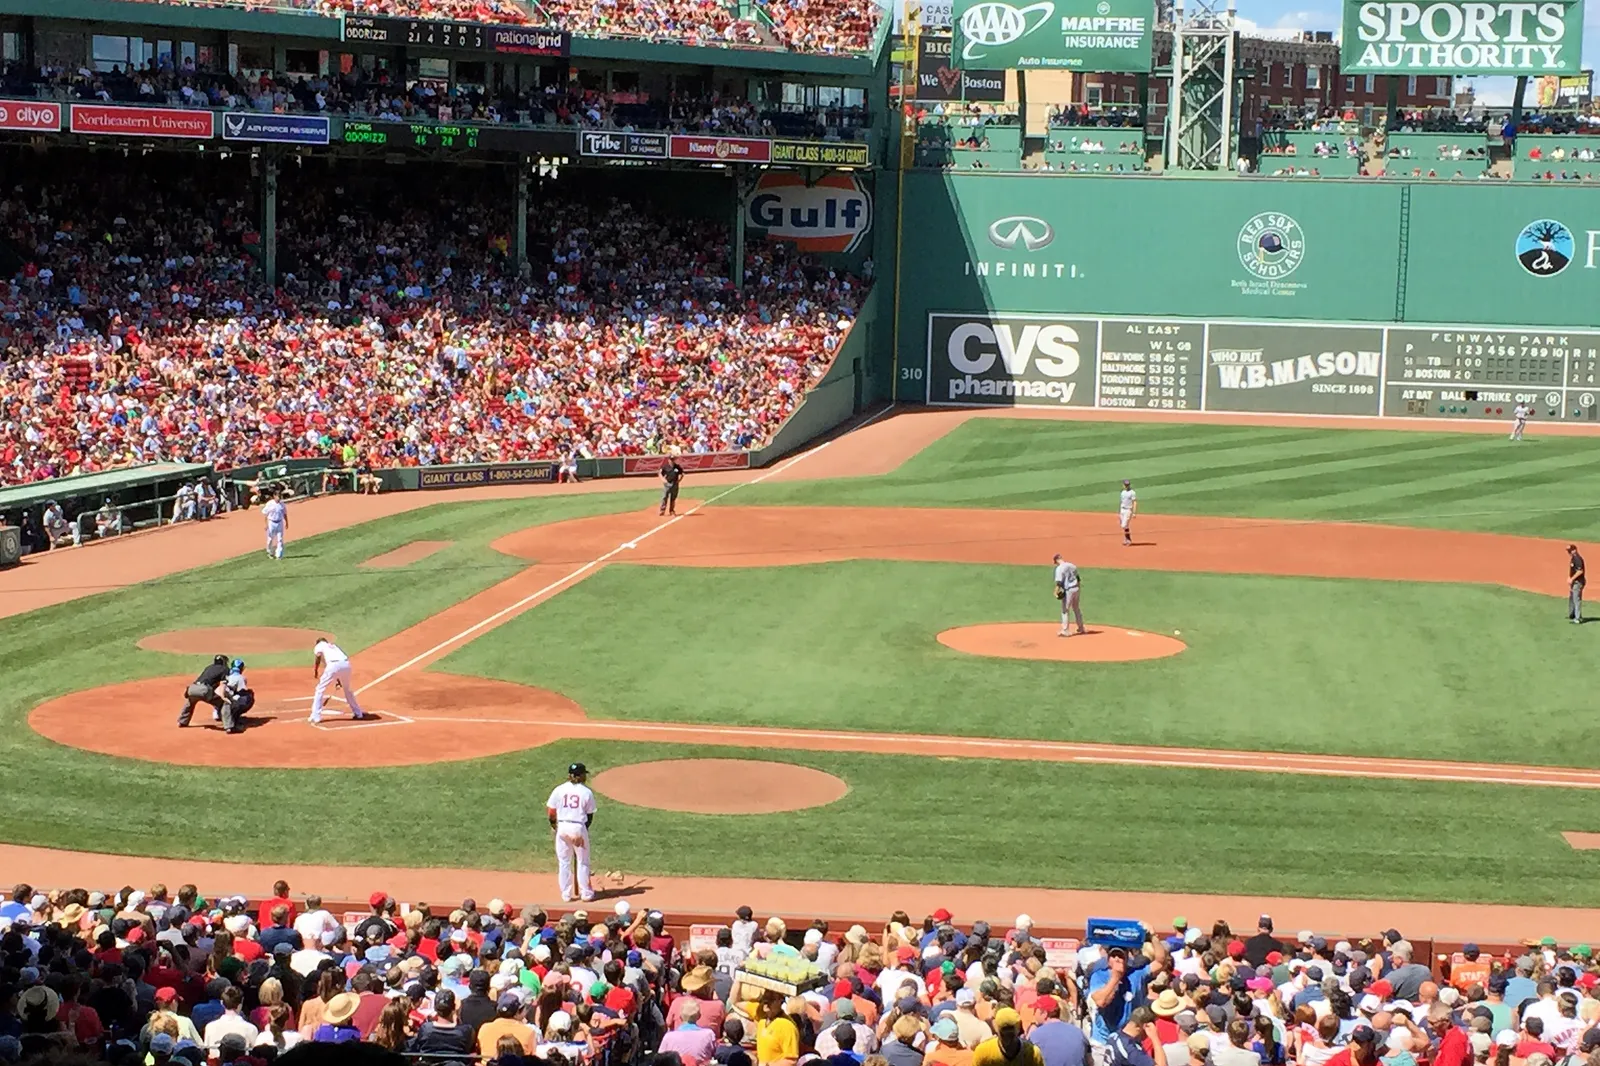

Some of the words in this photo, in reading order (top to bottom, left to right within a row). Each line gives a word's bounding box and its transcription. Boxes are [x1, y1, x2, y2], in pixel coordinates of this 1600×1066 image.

[926, 5, 953, 15] CAS
[966, 5, 1018, 42] AAA
[1061, 17, 1145, 31] MAPFRE
[1358, 2, 1565, 42] SPORTS
[346, 28, 387, 40] ODORIZZI
[427, 33, 434, 44] 4
[444, 35, 450, 45] 2
[460, 36, 466, 46] 0
[475, 37, 482, 47] 3
[1065, 37, 1140, 48] INSURANCE
[1018, 57, 1040, 66] Auto
[1041, 57, 1083, 66] Insurance
[920, 74, 938, 86] We
[963, 76, 1002, 89] Boston
[78, 112, 150, 127] Northeastern
[152, 115, 208, 131] University
[262, 126, 288, 134] FORCE
[290, 127, 326, 135] RESERVE
[410, 125, 432, 134] TOTAL
[345, 132, 387, 144] ODORIZZI
[586, 134, 621, 153] Tribe
[775, 145, 795, 159] GIANT
[796, 146, 819, 161] GLASS
[750, 194, 862, 228] Gulf
[1241, 218, 1264, 243] RED
[1268, 215, 1295, 233] SOX
[1243, 240, 1302, 276] SCHOLARS
[1126, 324, 1142, 334] AL
[1147, 325, 1180, 335] EAST
[1431, 333, 1506, 343] FENWAY
[1520, 336, 1568, 345] PARK
[948, 322, 1080, 377] CVS
[1149, 341, 1162, 350] W
[1166, 341, 1174, 350] L
[1176, 341, 1191, 351] GB
[1405, 343, 1414, 353] P
[1573, 348, 1581, 357] R
[1588, 349, 1596, 358] H
[1102, 352, 1120, 361] NEW
[1122, 353, 1145, 361] YORK
[1211, 352, 1238, 362] WHO
[1240, 352, 1263, 362] BUT
[1102, 363, 1146, 373] BALTIMORE
[1149, 364, 1161, 374] 53
[1163, 365, 1175, 374] 50
[1180, 365, 1187, 375] 5
[1427, 356, 1441, 366] TB
[1588, 362, 1595, 371] 2
[901, 367, 923, 380] 310
[1415, 369, 1452, 379] BOSTON
[1572, 373, 1579, 383] 2
[1587, 374, 1594, 383] 4
[1102, 375, 1142, 385] TORONTO
[1148, 376, 1160, 385] 53
[1162, 377, 1174, 386] 52
[1179, 377, 1186, 386] 6
[949, 375, 1076, 403] pharmacy
[1102, 386, 1127, 395] TAMPA
[1128, 387, 1145, 396] BAY
[1149, 387, 1159, 397] 51
[1162, 388, 1174, 397] 54
[1312, 384, 1347, 394] SINCE
[1349, 385, 1374, 395] 1898
[1402, 390, 1415, 400] AT
[1416, 391, 1433, 400] BAT
[1441, 391, 1466, 401] BALL
[1477, 392, 1511, 402] STRIKE
[1515, 393, 1537, 403] OUT
[1100, 398, 1136, 407] BOSTON
[1147, 399, 1159, 408] 47
[1176, 400, 1187, 409] 12
[423, 473, 451, 484] GIANT
[453, 471, 484, 482] GLASS
[562, 794, 580, 809] 13
